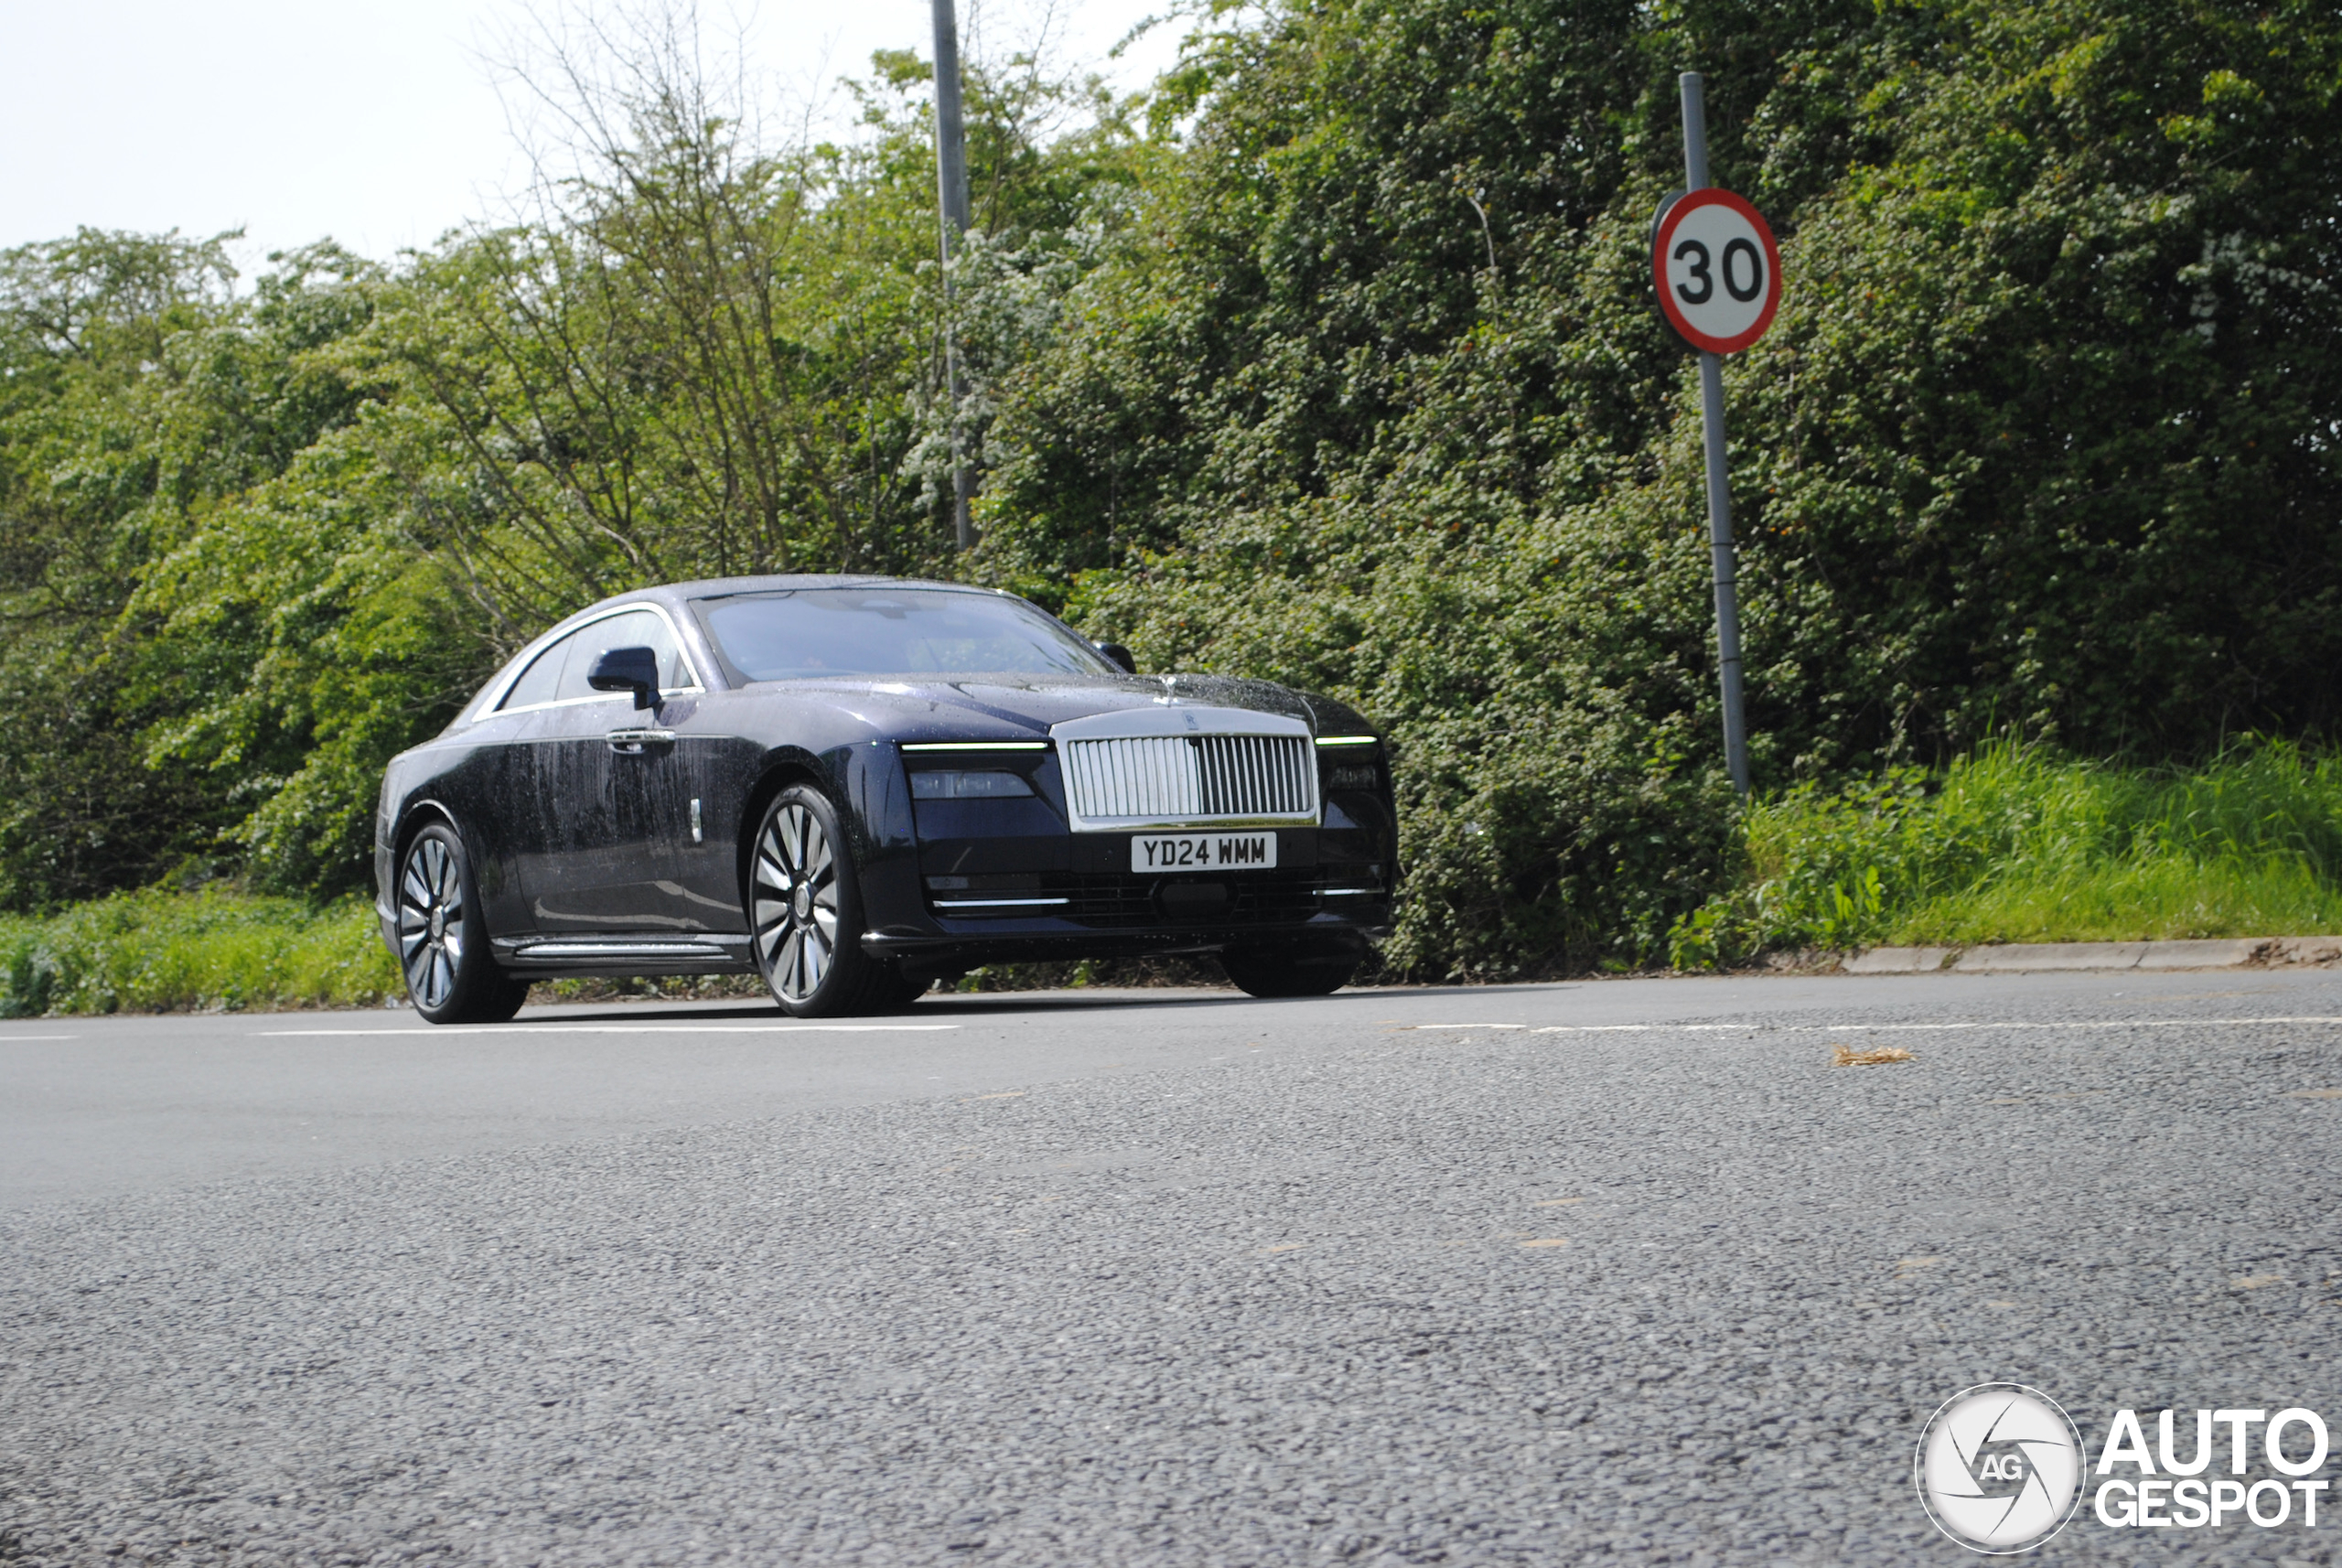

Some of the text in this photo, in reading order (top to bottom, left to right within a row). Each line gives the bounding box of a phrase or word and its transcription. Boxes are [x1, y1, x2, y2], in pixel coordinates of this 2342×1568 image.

[1673, 237, 1763, 305] 30
[1144, 837, 1265, 866] YD24 WMM
